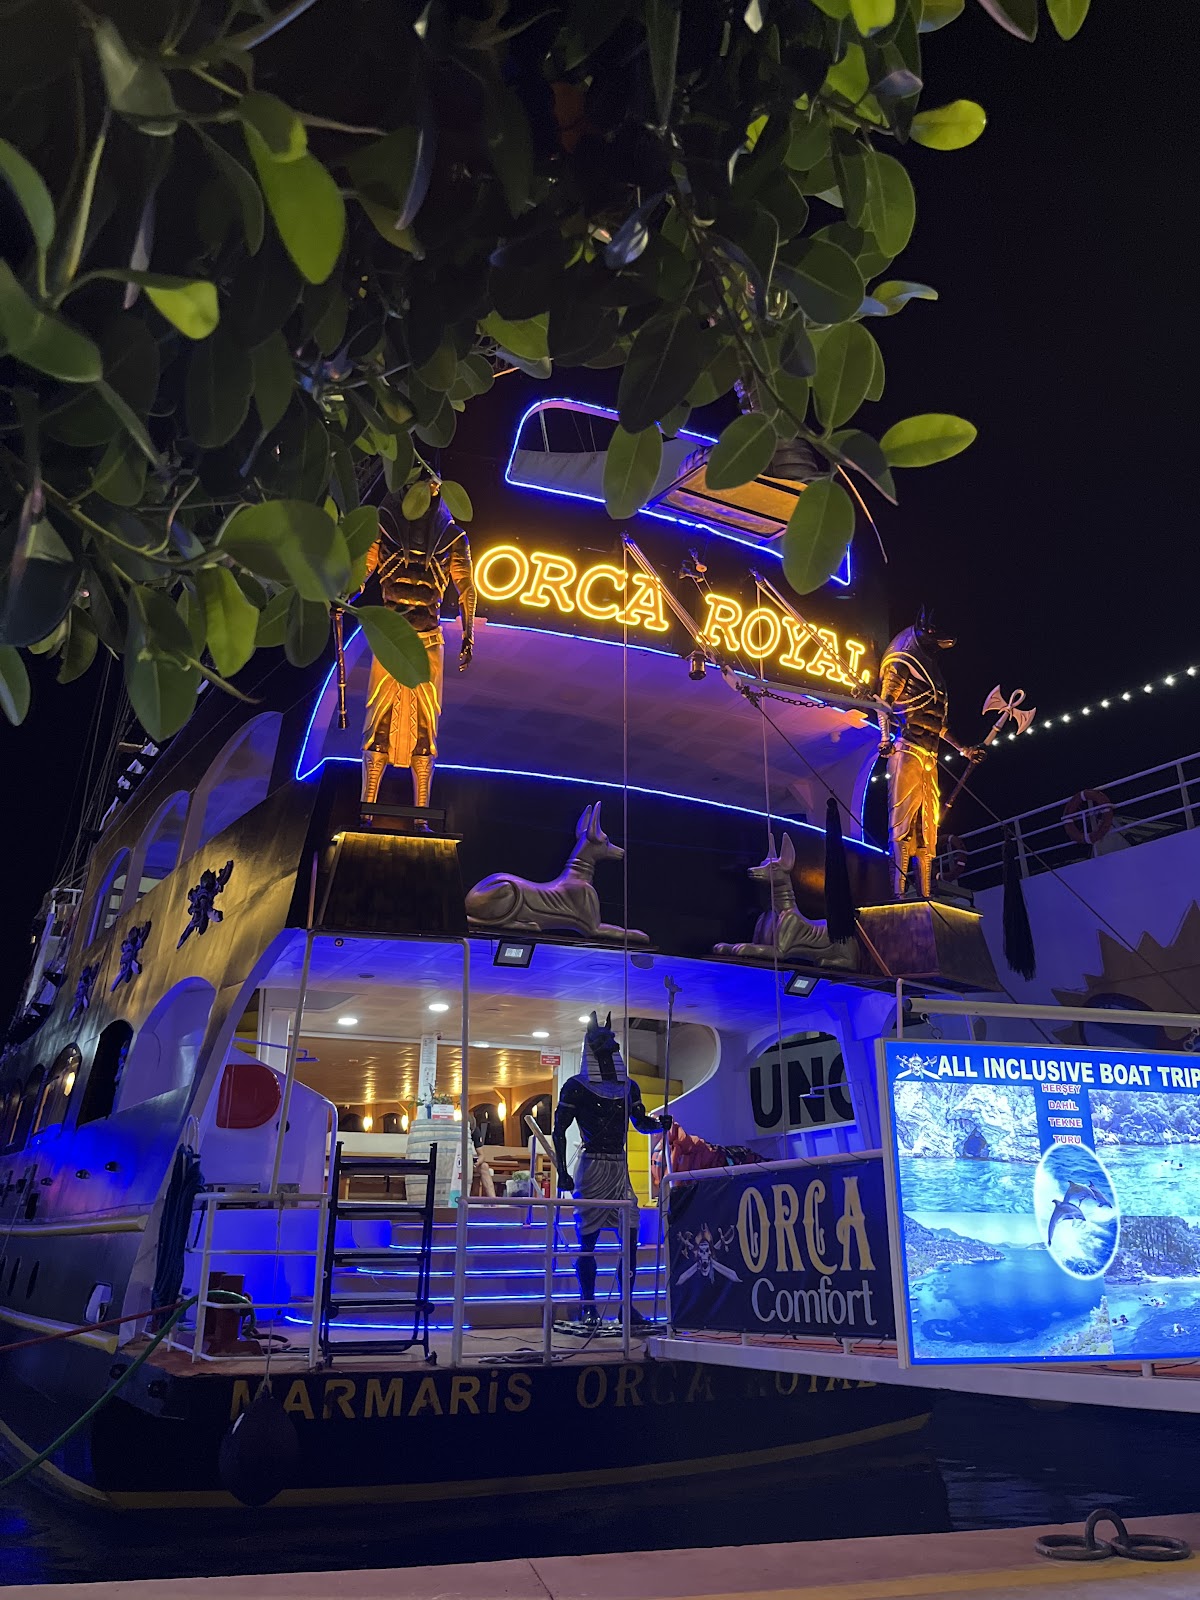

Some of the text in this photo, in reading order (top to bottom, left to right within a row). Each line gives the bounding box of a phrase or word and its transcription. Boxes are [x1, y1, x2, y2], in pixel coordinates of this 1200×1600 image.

[474, 545, 870, 687] ORCA ROYAL
[937, 1055, 1200, 1088] ALL INCLUSIVE BOAT TRIP
[1041, 1083, 1081, 1095] HERŞEY
[1048, 1099, 1079, 1111] DAHİL
[1048, 1117, 1083, 1128] TEKNE
[1053, 1135, 1081, 1144] TURU
[736, 1176, 876, 1275] ORCA
[751, 1276, 877, 1326] Comfort
[576, 1363, 714, 1409] ORCA
